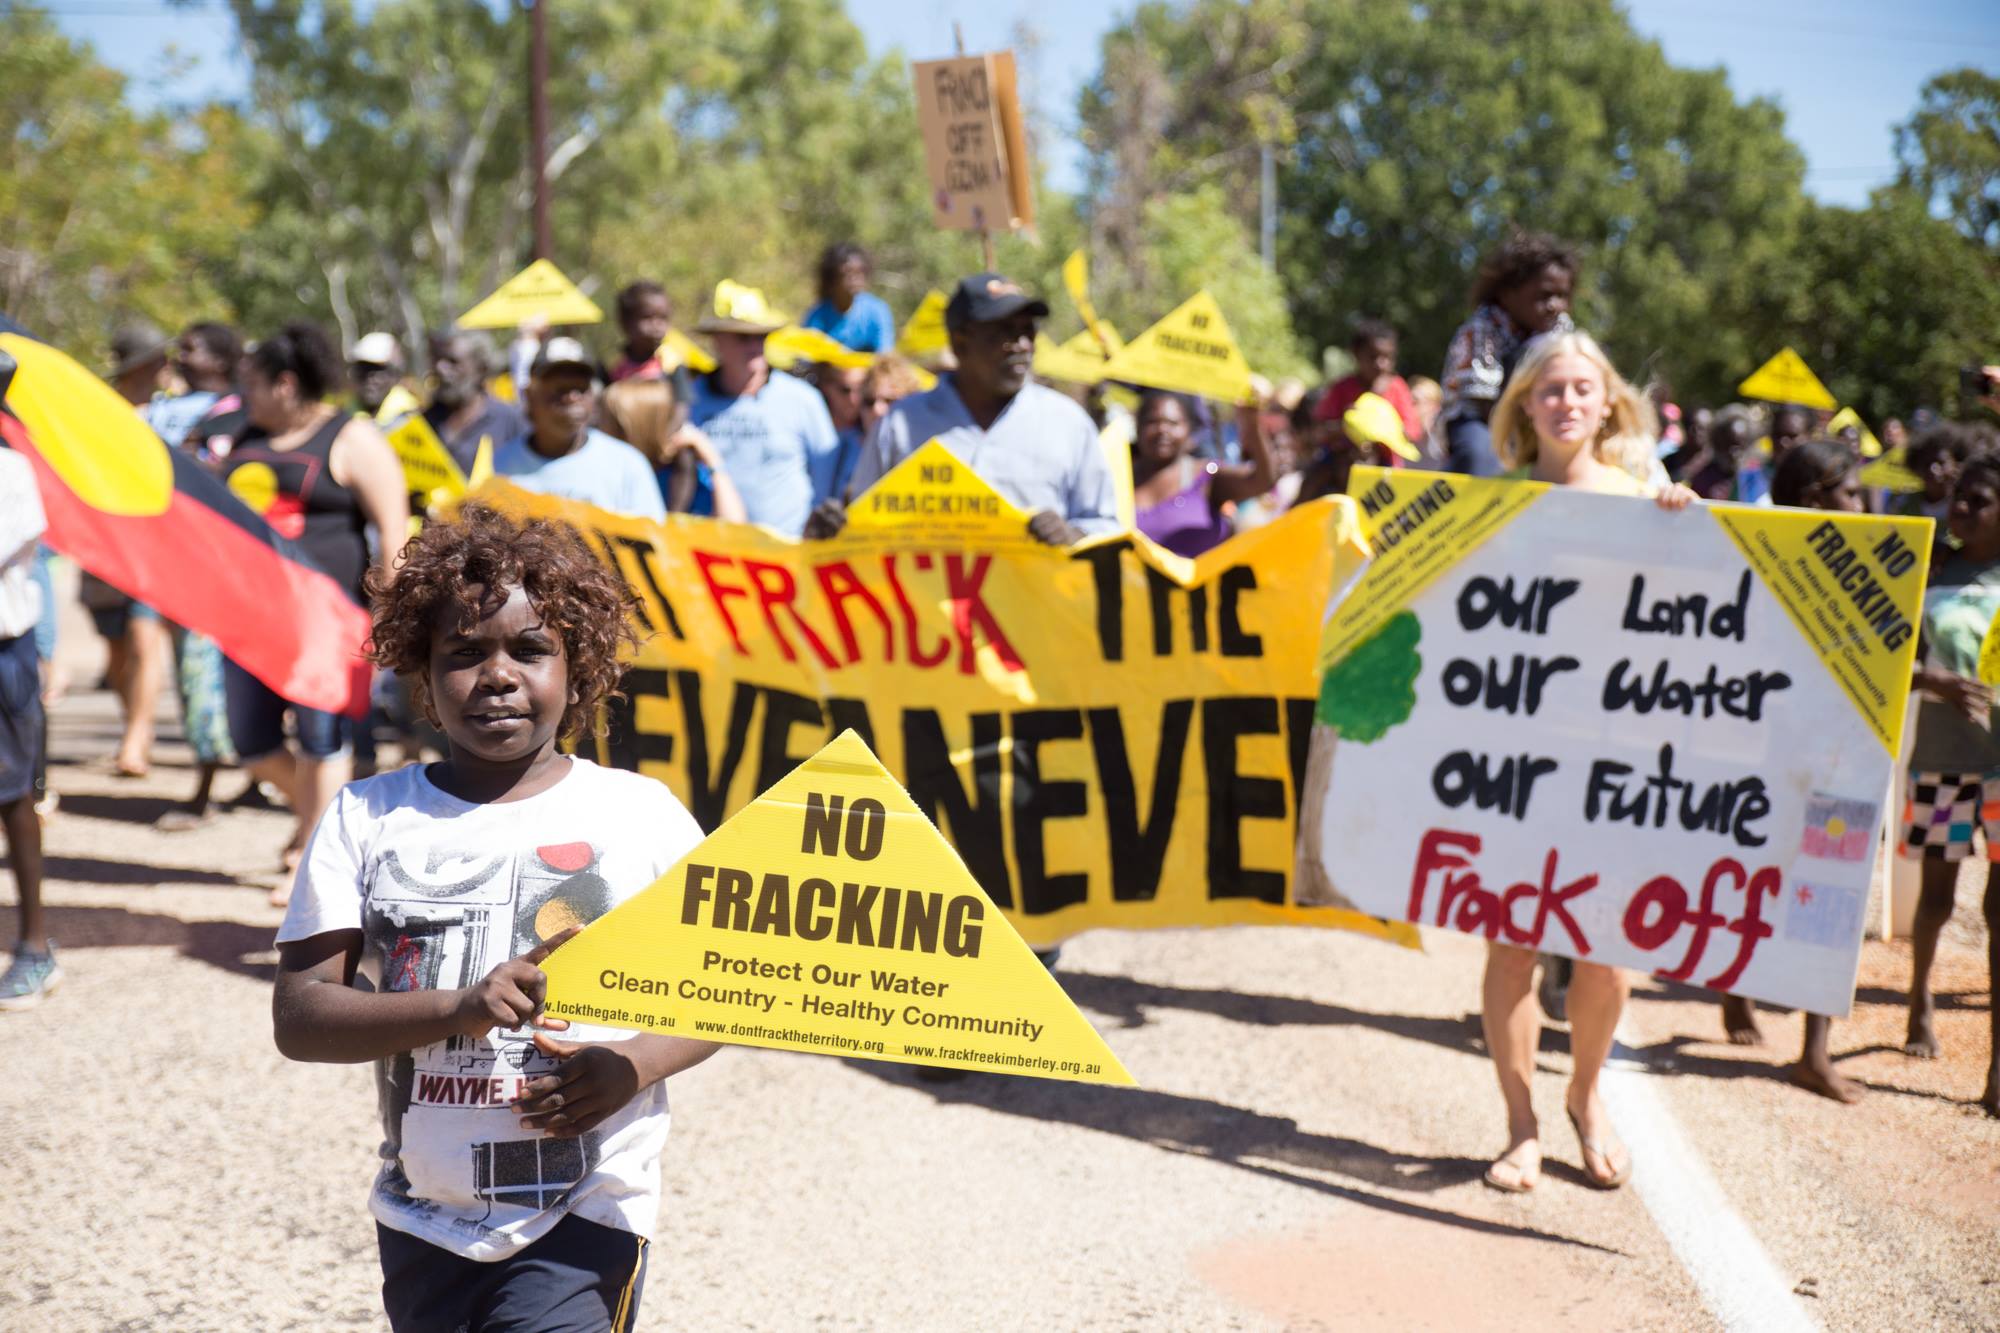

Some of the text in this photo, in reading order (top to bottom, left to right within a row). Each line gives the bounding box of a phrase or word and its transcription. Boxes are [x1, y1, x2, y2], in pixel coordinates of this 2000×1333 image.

[872, 492, 1000, 517] FRACKING
[920, 463, 954, 484] NO
[1359, 479, 1396, 518] NO
[1371, 479, 1456, 559] ACKING
[1872, 529, 1917, 580] NO
[690, 548, 1027, 676] FRACK
[1622, 568, 1752, 642] Land
[1805, 520, 1913, 653] FRACKING
[1601, 657, 1792, 721] Water
[801, 792, 887, 861] NO
[900, 696, 1315, 917] NEVE
[1584, 743, 1772, 847] Future
[681, 863, 985, 958] FRACKING
[1407, 827, 1782, 990] Frack Off
[599, 969, 669, 996] Clean
[677, 979, 777, 1012] Country
[801, 994, 895, 1026] Healthy
[902, 1005, 1043, 1042] Community
[702, 950, 949, 998] Protect Our Water
[695, 1019, 884, 1053] www.dontfracktheterritory.org
[903, 1043, 1101, 1075] www.frackfreekimberley.org.au
[418, 1074, 504, 1105] WAYNE
